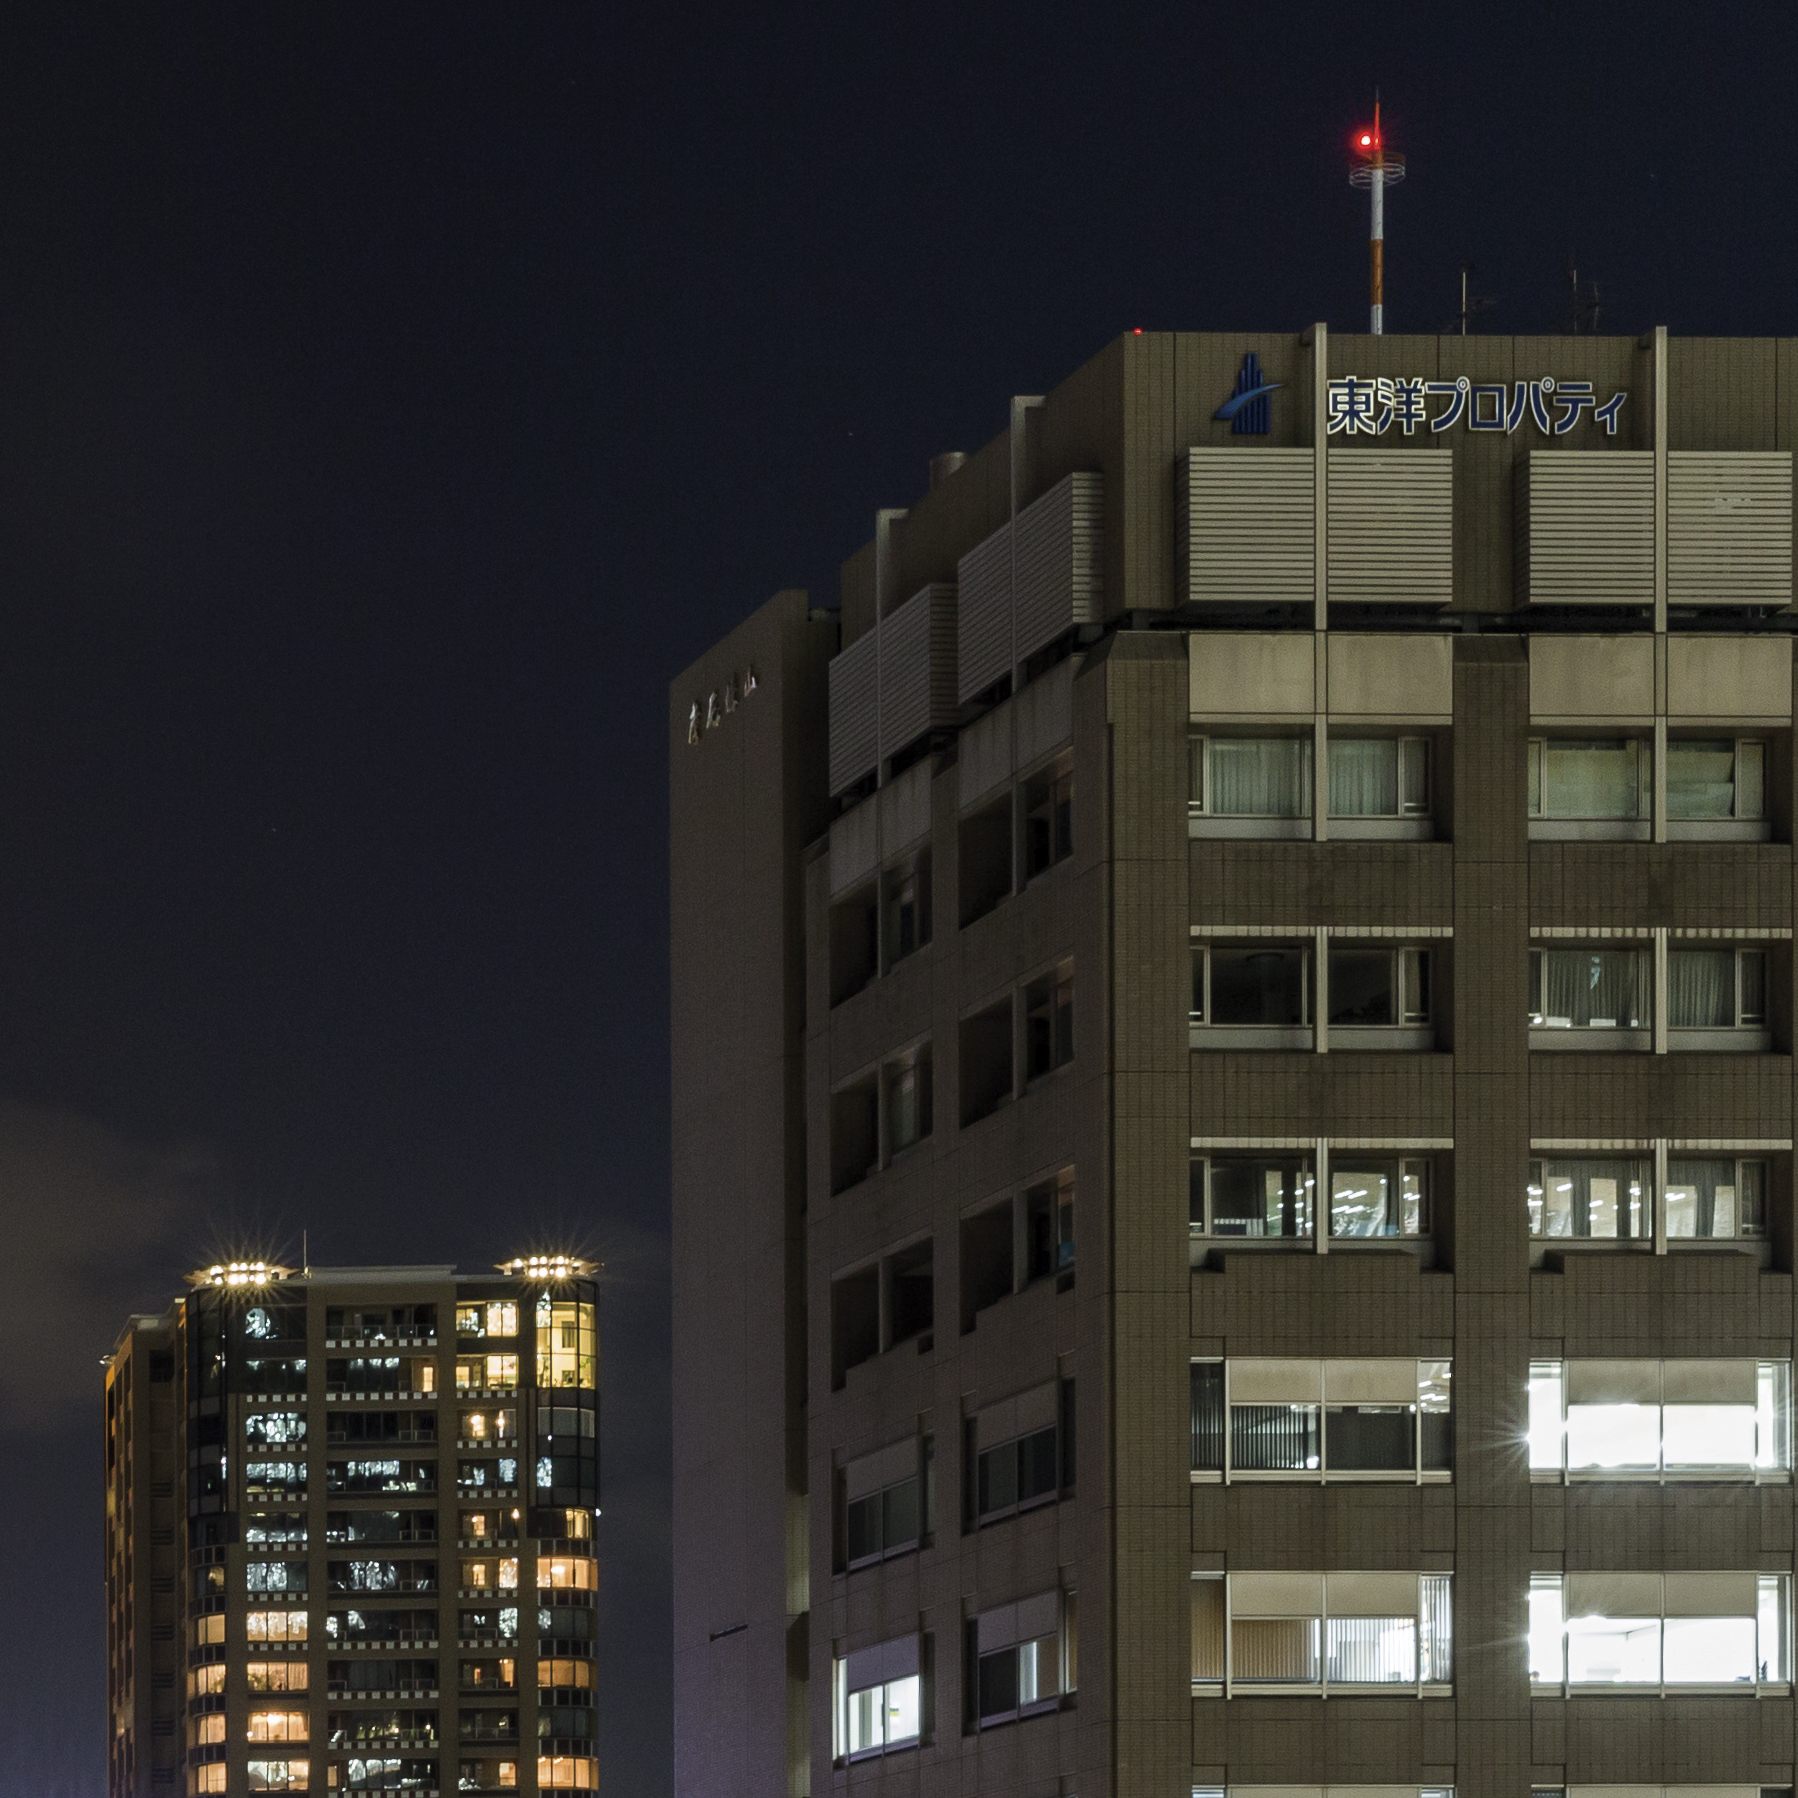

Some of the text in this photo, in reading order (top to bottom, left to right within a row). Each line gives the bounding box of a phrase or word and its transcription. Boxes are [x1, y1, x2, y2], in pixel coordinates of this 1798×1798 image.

[1326, 375, 1628, 436] 東洋プロパティ
